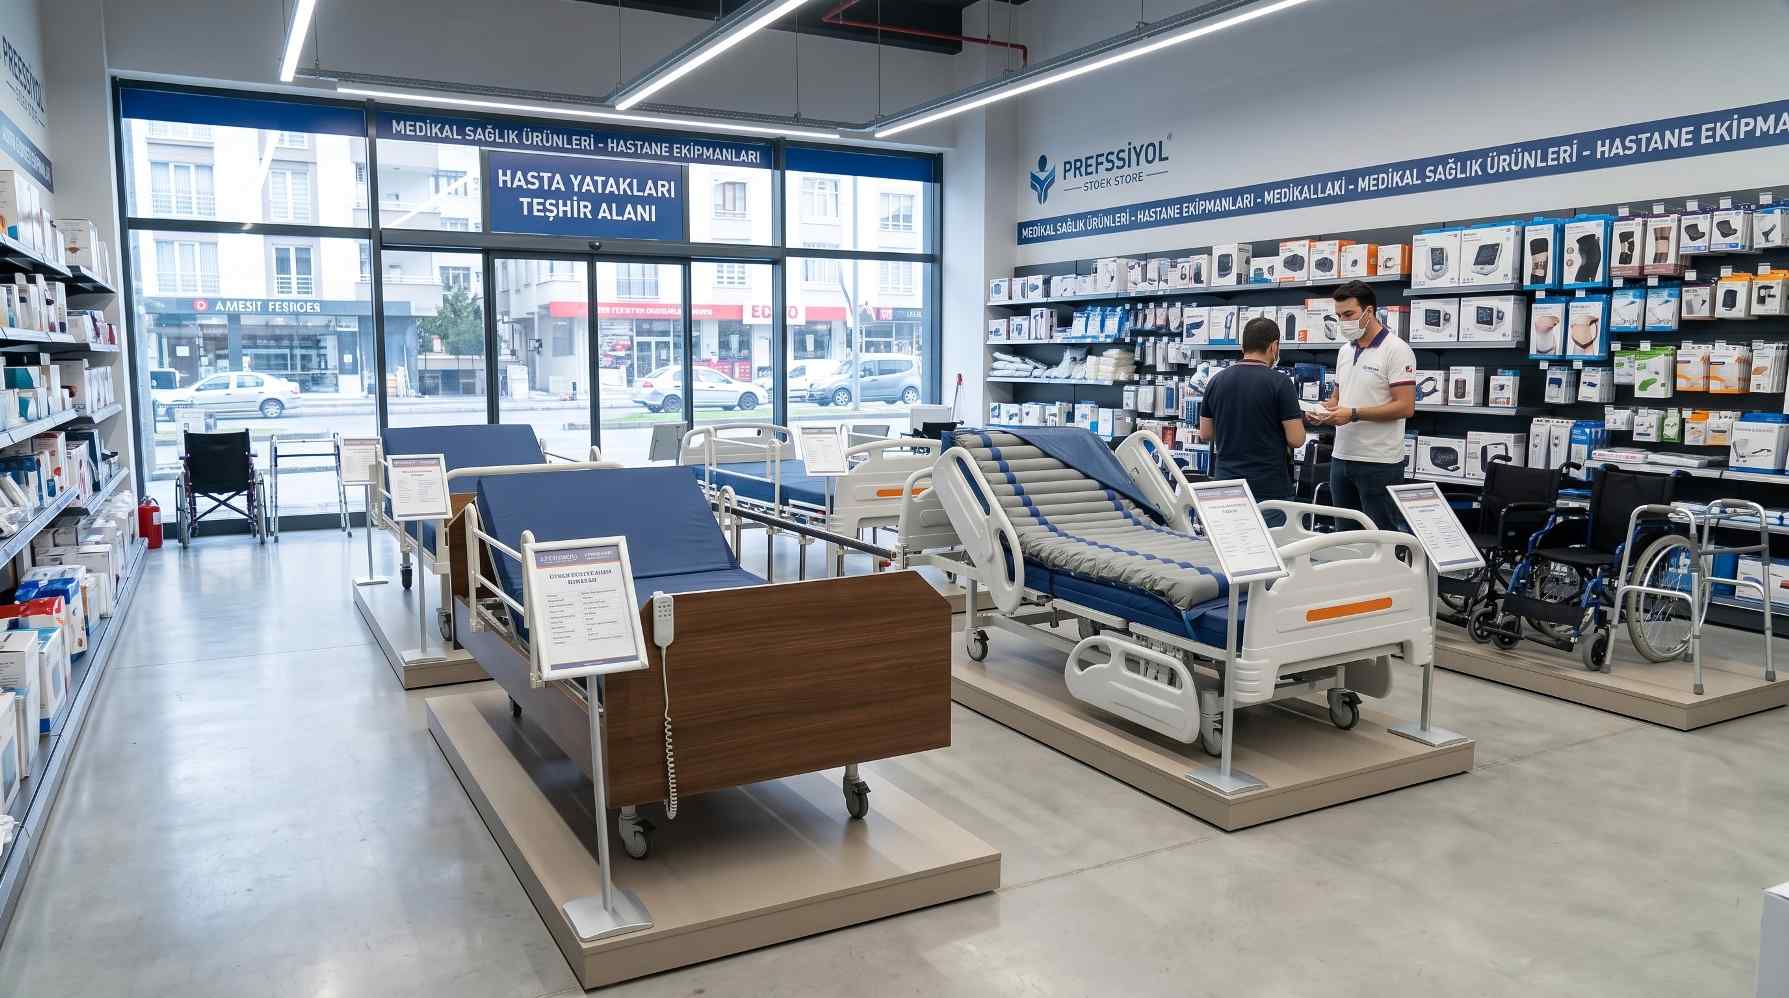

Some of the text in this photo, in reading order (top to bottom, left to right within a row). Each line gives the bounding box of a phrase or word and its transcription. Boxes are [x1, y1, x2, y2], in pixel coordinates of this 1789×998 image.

[392, 119, 462, 139] MEDİKAL
[465, 124, 519, 144] SAĞLIK
[522, 128, 594, 150] ÜRÜNLERİ
[607, 138, 670, 156] HASTANE
[673, 142, 760, 164] EKİPMANLARI
[1063, 140, 1169, 181] PREFSSİYOL
[497, 168, 675, 198] HASTA YATAKLARI
[1022, 222, 1055, 239] MEDİKAL
[1057, 218, 1086, 233] SAĞLIK
[1087, 209, 1130, 230] ÜRÜNLERİ
[1137, 205, 1180, 224] HASTANE
[1182, 193, 1254, 217] EKİPMANLARI
[1264, 176, 1345, 205] MEDİKALLAKİ
[1358, 168, 1421, 193] MEDİKAL
[1425, 157, 1482, 183] SAĞLIK
[1487, 140, 1579, 174] ÜRÜNLERİ
[1596, 126, 1694, 159] HASTANE
[1114, 172, 1144, 186] STORE
[519, 196, 656, 222] TEŞHİR ALANI
